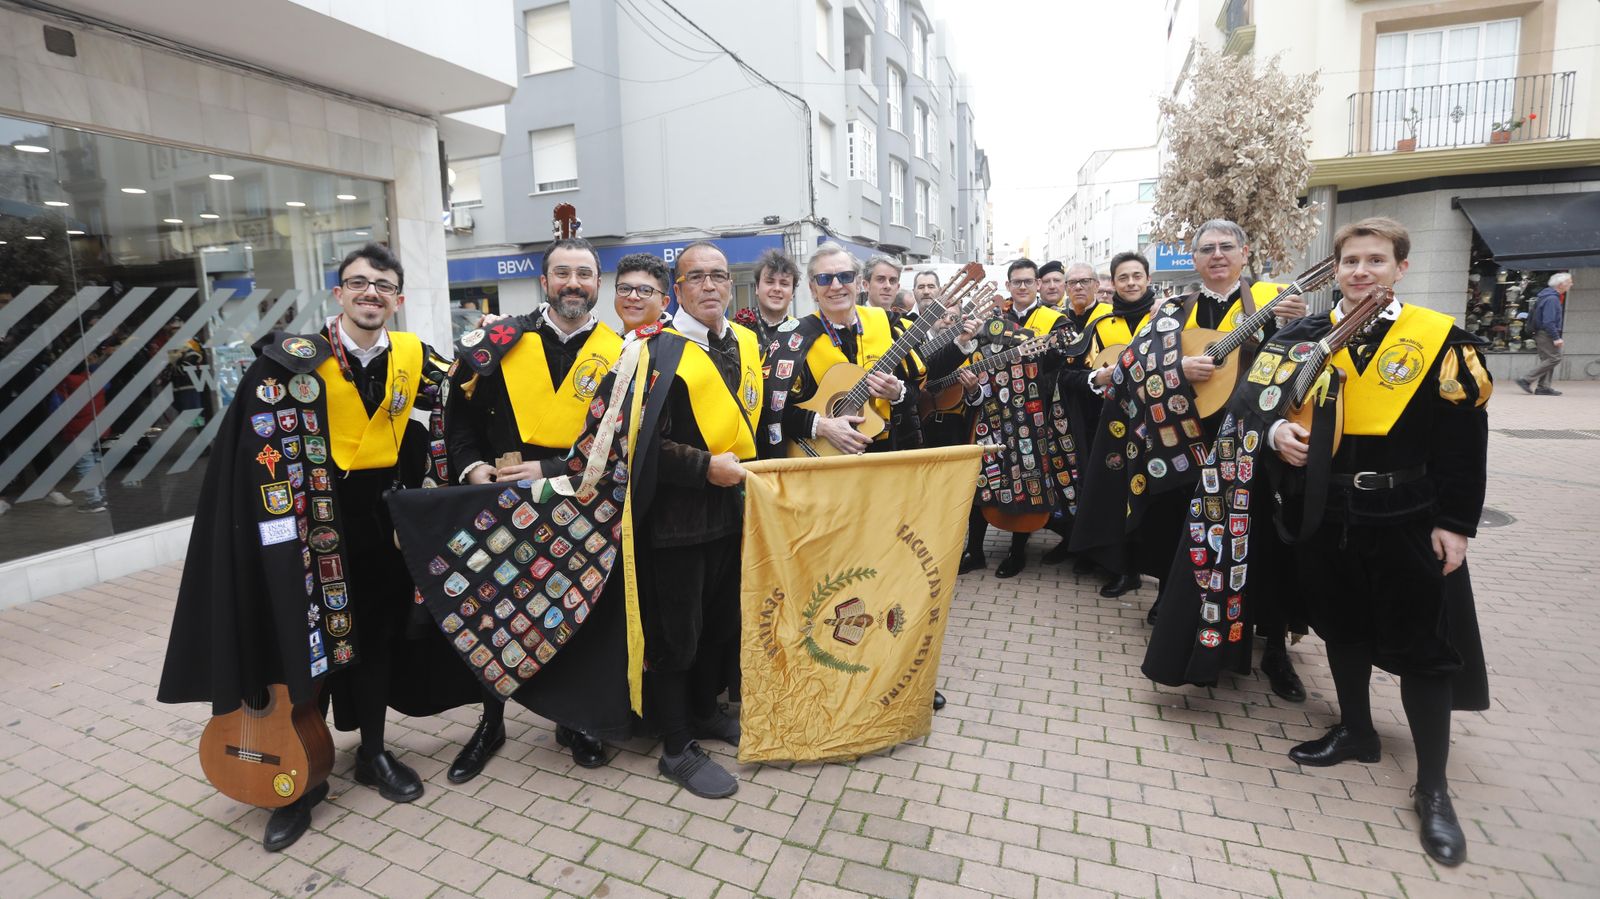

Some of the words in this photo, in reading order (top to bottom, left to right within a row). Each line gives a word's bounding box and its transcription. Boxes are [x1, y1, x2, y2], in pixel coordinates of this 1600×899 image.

[497, 258, 535, 275] BBVA
[1160, 245, 1174, 256] LA
[896, 523, 941, 599] FACULTAD
[759, 587, 786, 659] SEVILLA
[928, 607, 940, 626] DE
[880, 634, 933, 706] MEDICINA
